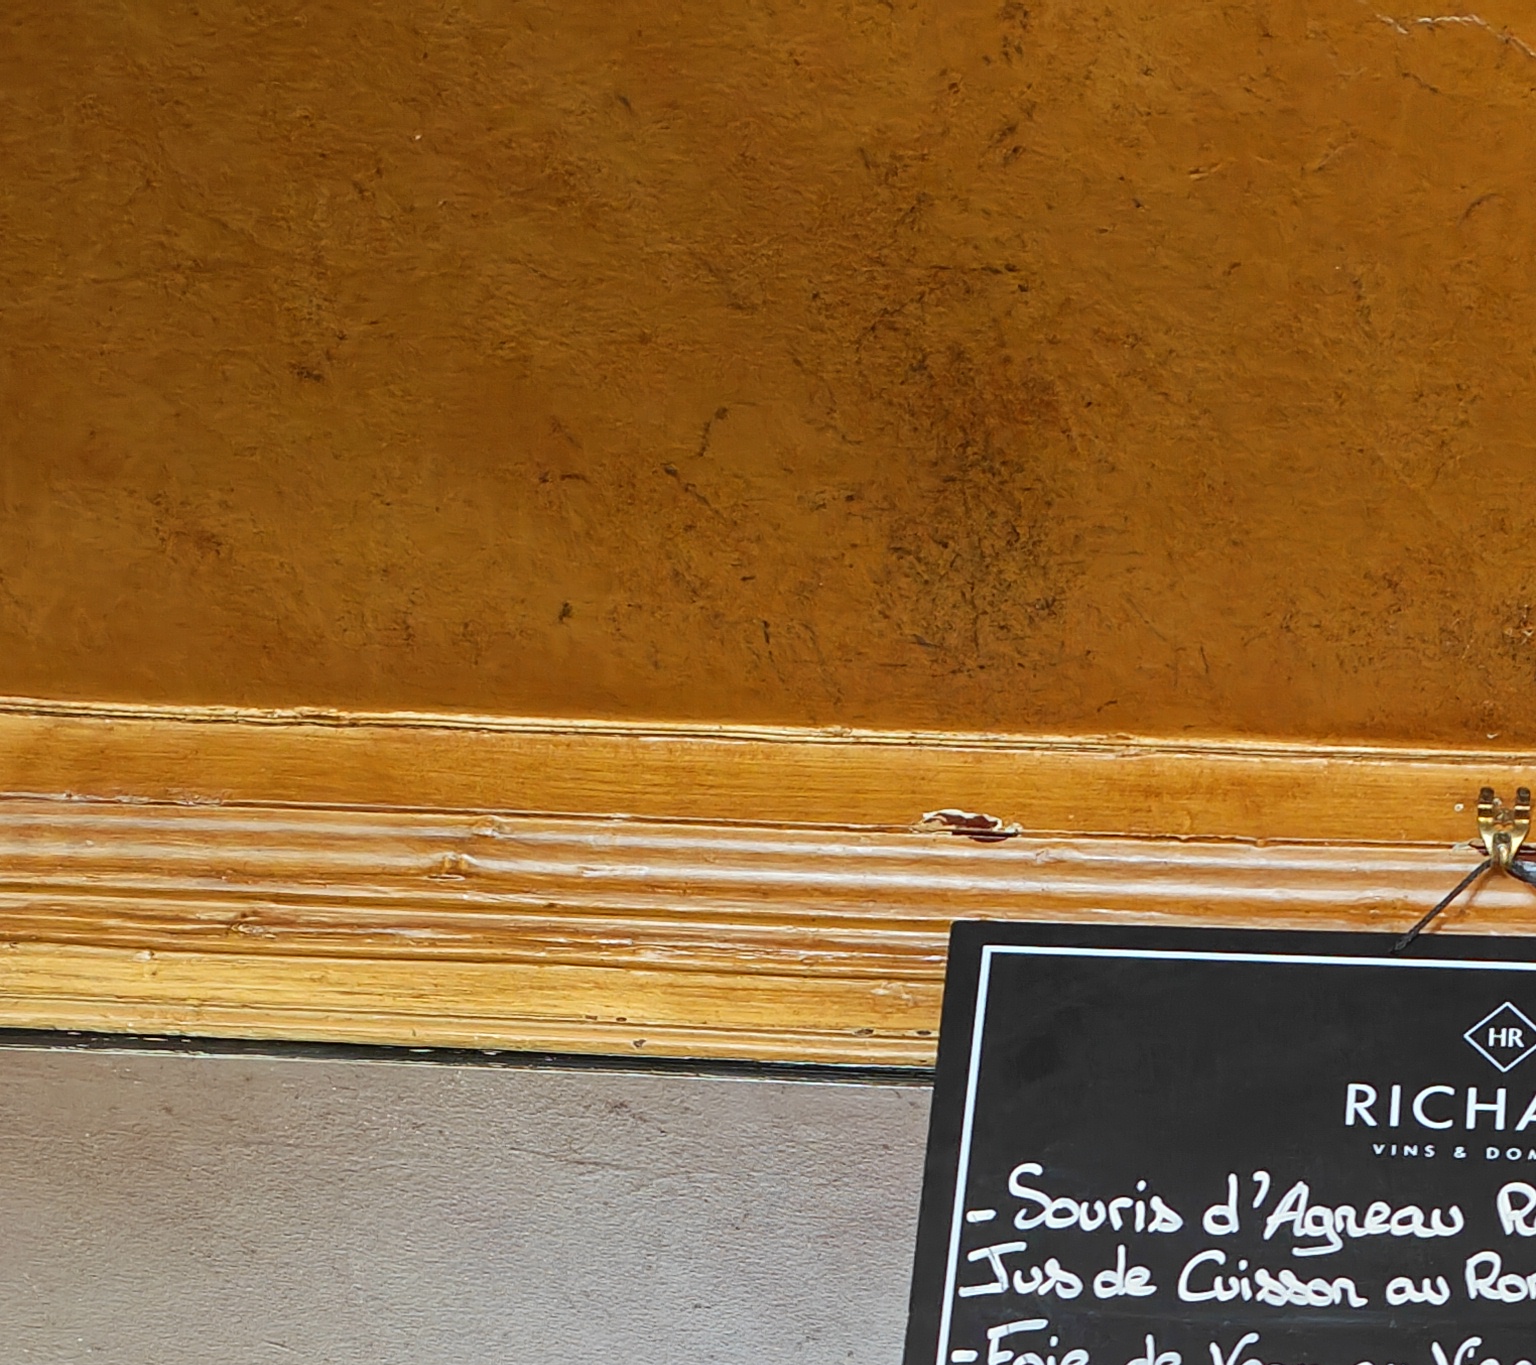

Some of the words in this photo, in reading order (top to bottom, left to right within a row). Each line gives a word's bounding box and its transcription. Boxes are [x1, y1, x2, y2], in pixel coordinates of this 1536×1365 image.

[1487, 1026, 1526, 1049] HR
[1372, 1143, 1436, 1159] VINS
[1453, 1146, 1467, 1159] &
[957, 1241, 1083, 1298] Jus
[1092, 1245, 1158, 1299] de
[1177, 1249, 1369, 1308] Cuisson
[1385, 1275, 1451, 1306] au
